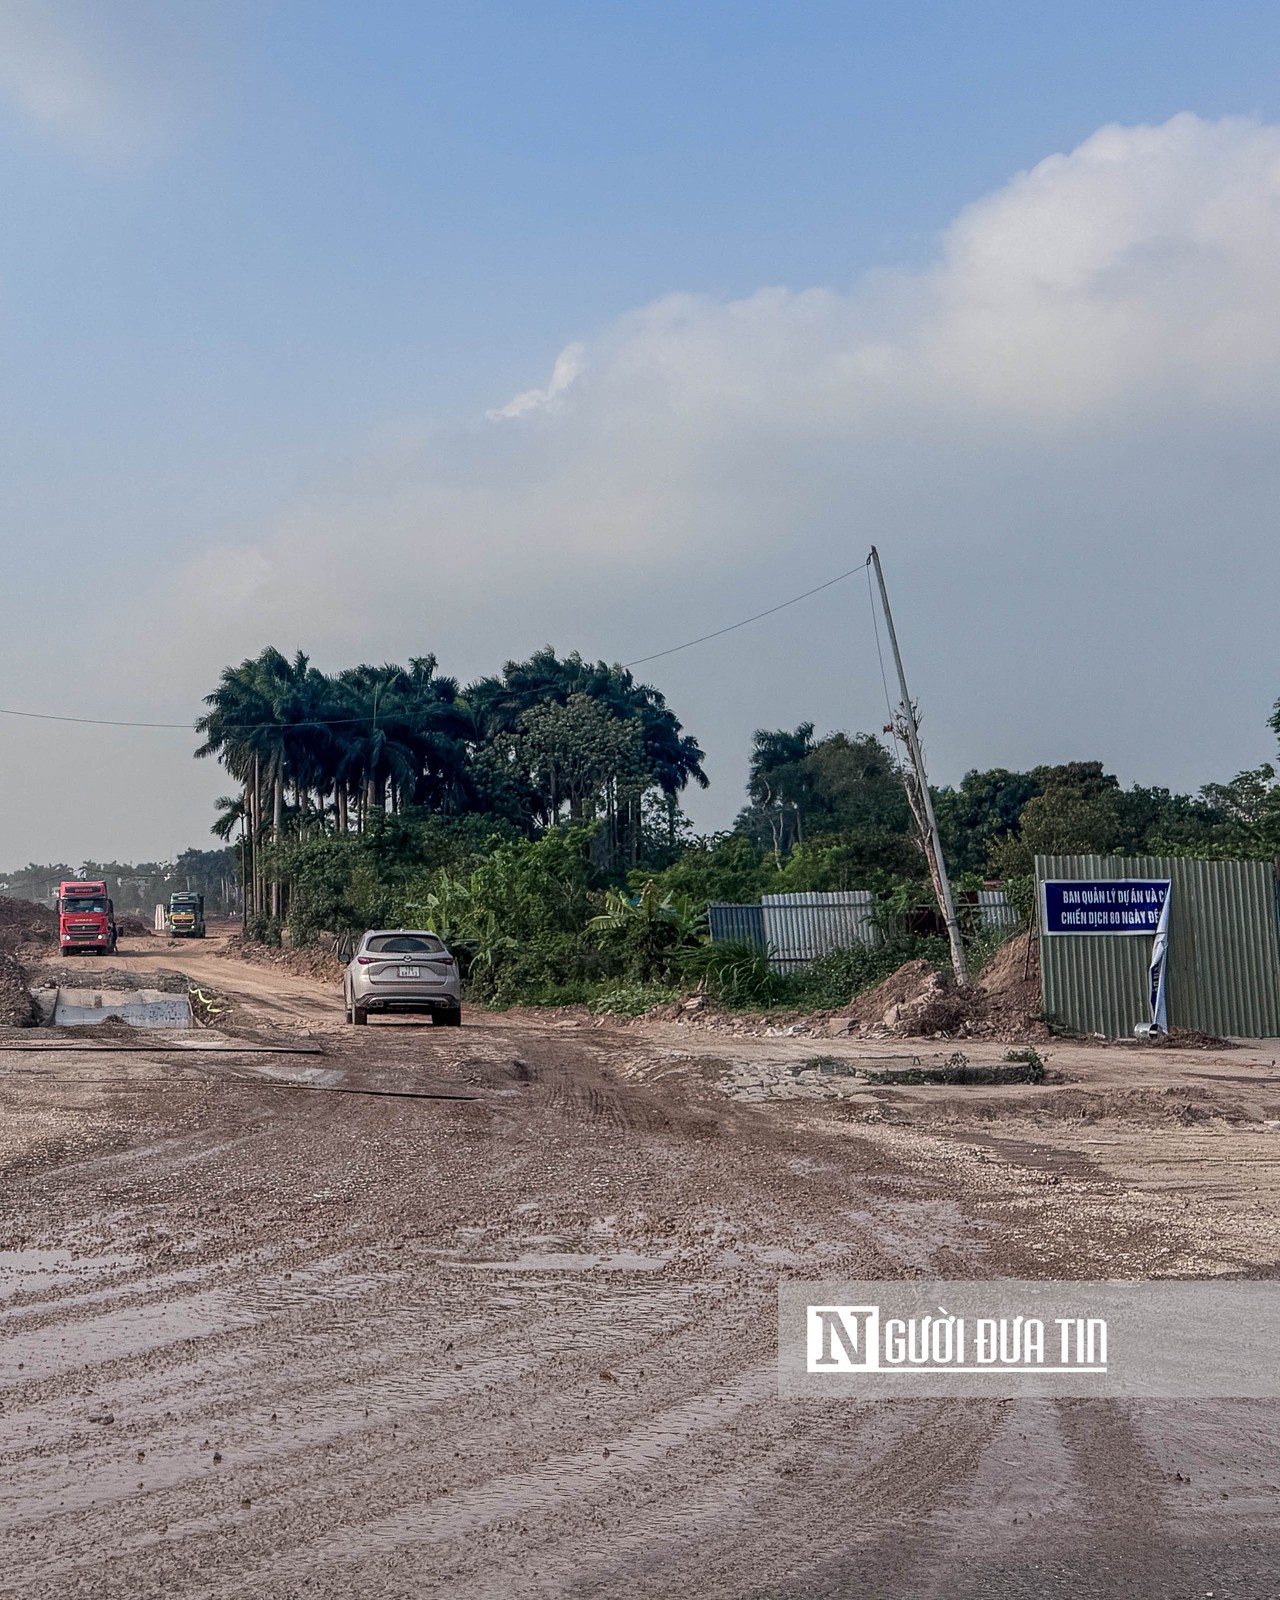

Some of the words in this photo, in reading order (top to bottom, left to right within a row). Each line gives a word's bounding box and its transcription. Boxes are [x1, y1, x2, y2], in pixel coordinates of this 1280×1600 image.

[1063, 890, 1081, 903] BAN
[1082, 886, 1105, 905] QUẢN
[1107, 888, 1116, 903] LÝ
[1118, 889, 1130, 906] DỰ
[1131, 887, 1144, 904] ÁN
[1145, 887, 1158, 904] VÀ
[1061, 907, 1087, 924] CHIẾN
[1088, 911, 1109, 927] DỊCH
[1110, 911, 1120, 924] 80
[1121, 908, 1146, 925] NGÀY
[1148, 908, 1160, 924] ĐÊ
